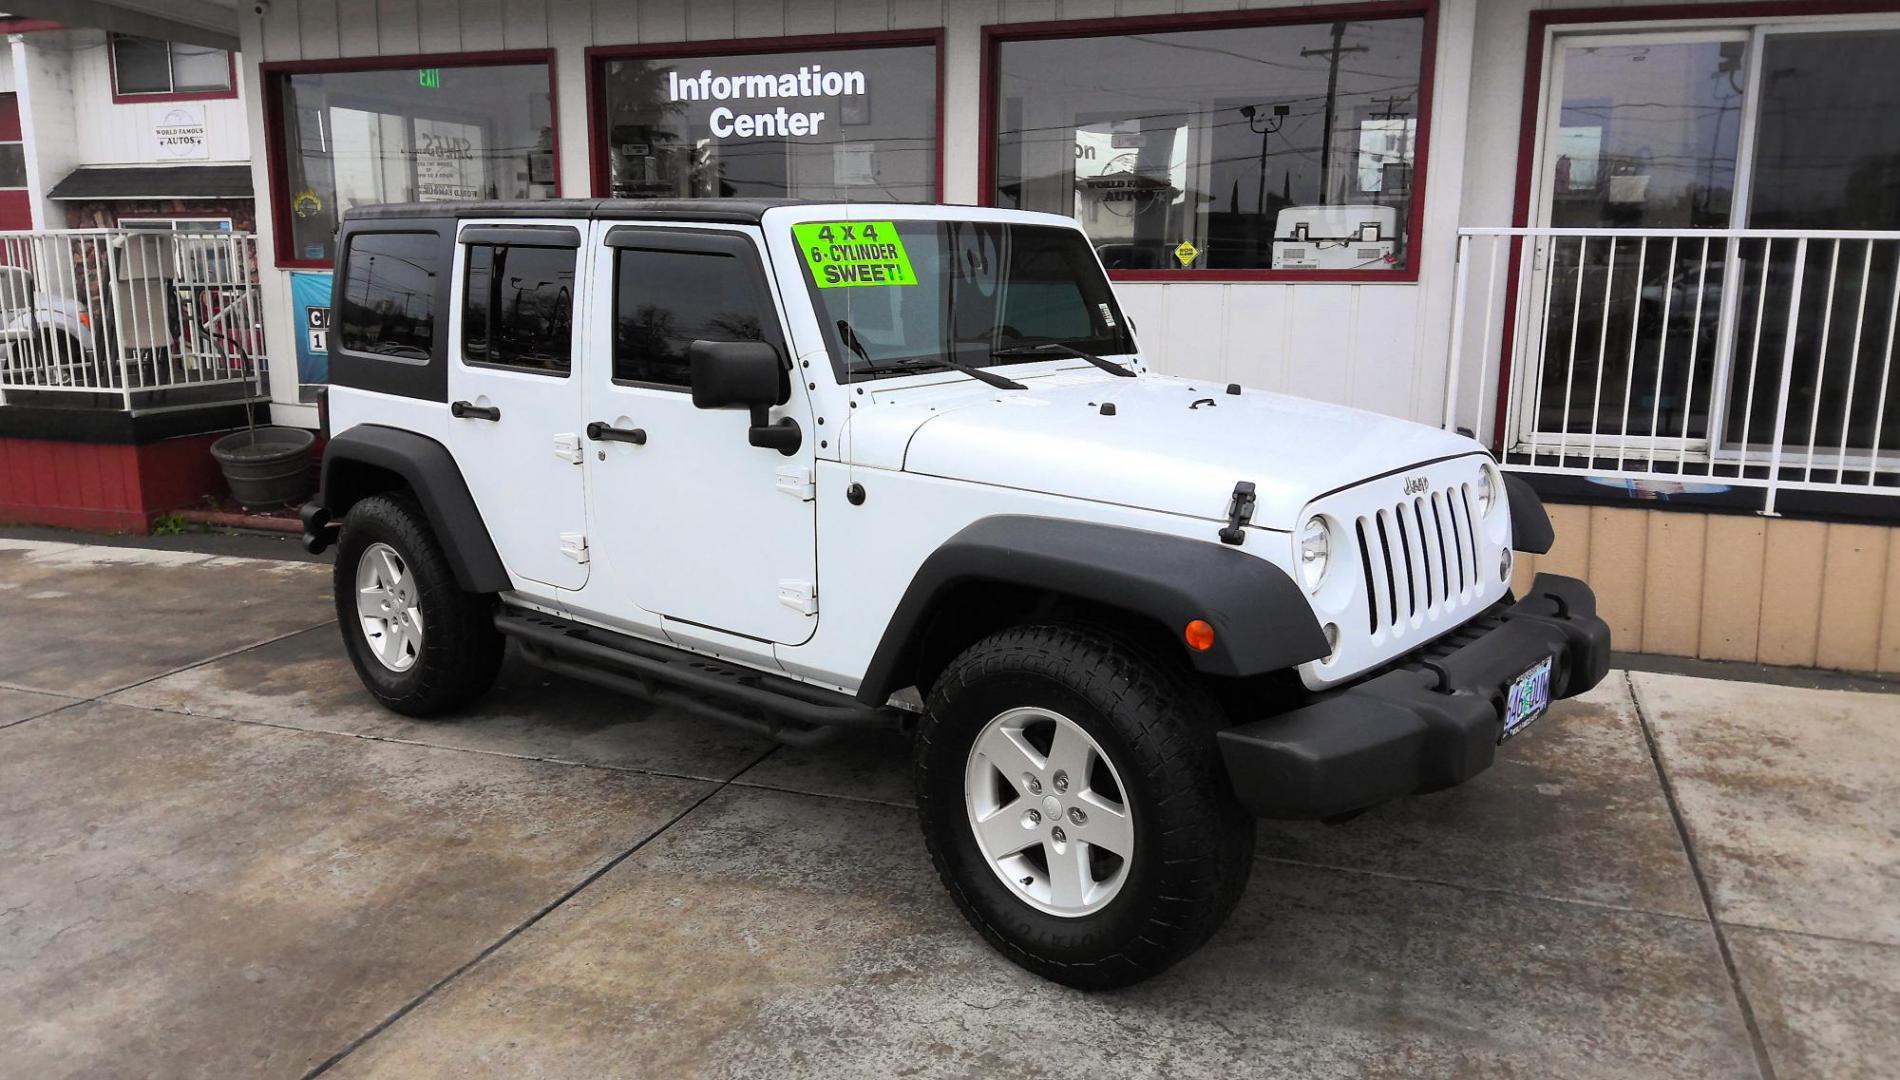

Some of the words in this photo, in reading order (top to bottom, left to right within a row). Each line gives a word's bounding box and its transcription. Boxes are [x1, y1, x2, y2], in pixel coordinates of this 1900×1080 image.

[669, 64, 865, 101] Information
[709, 106, 825, 138] Center
[167, 137, 195, 145] AUTOS
[818, 225, 835, 243] 4
[863, 224, 878, 241] 4
[811, 243, 898, 262] 6-CYLINDER
[824, 264, 903, 283] SWEET!
[1404, 476, 1430, 495] Jeep
